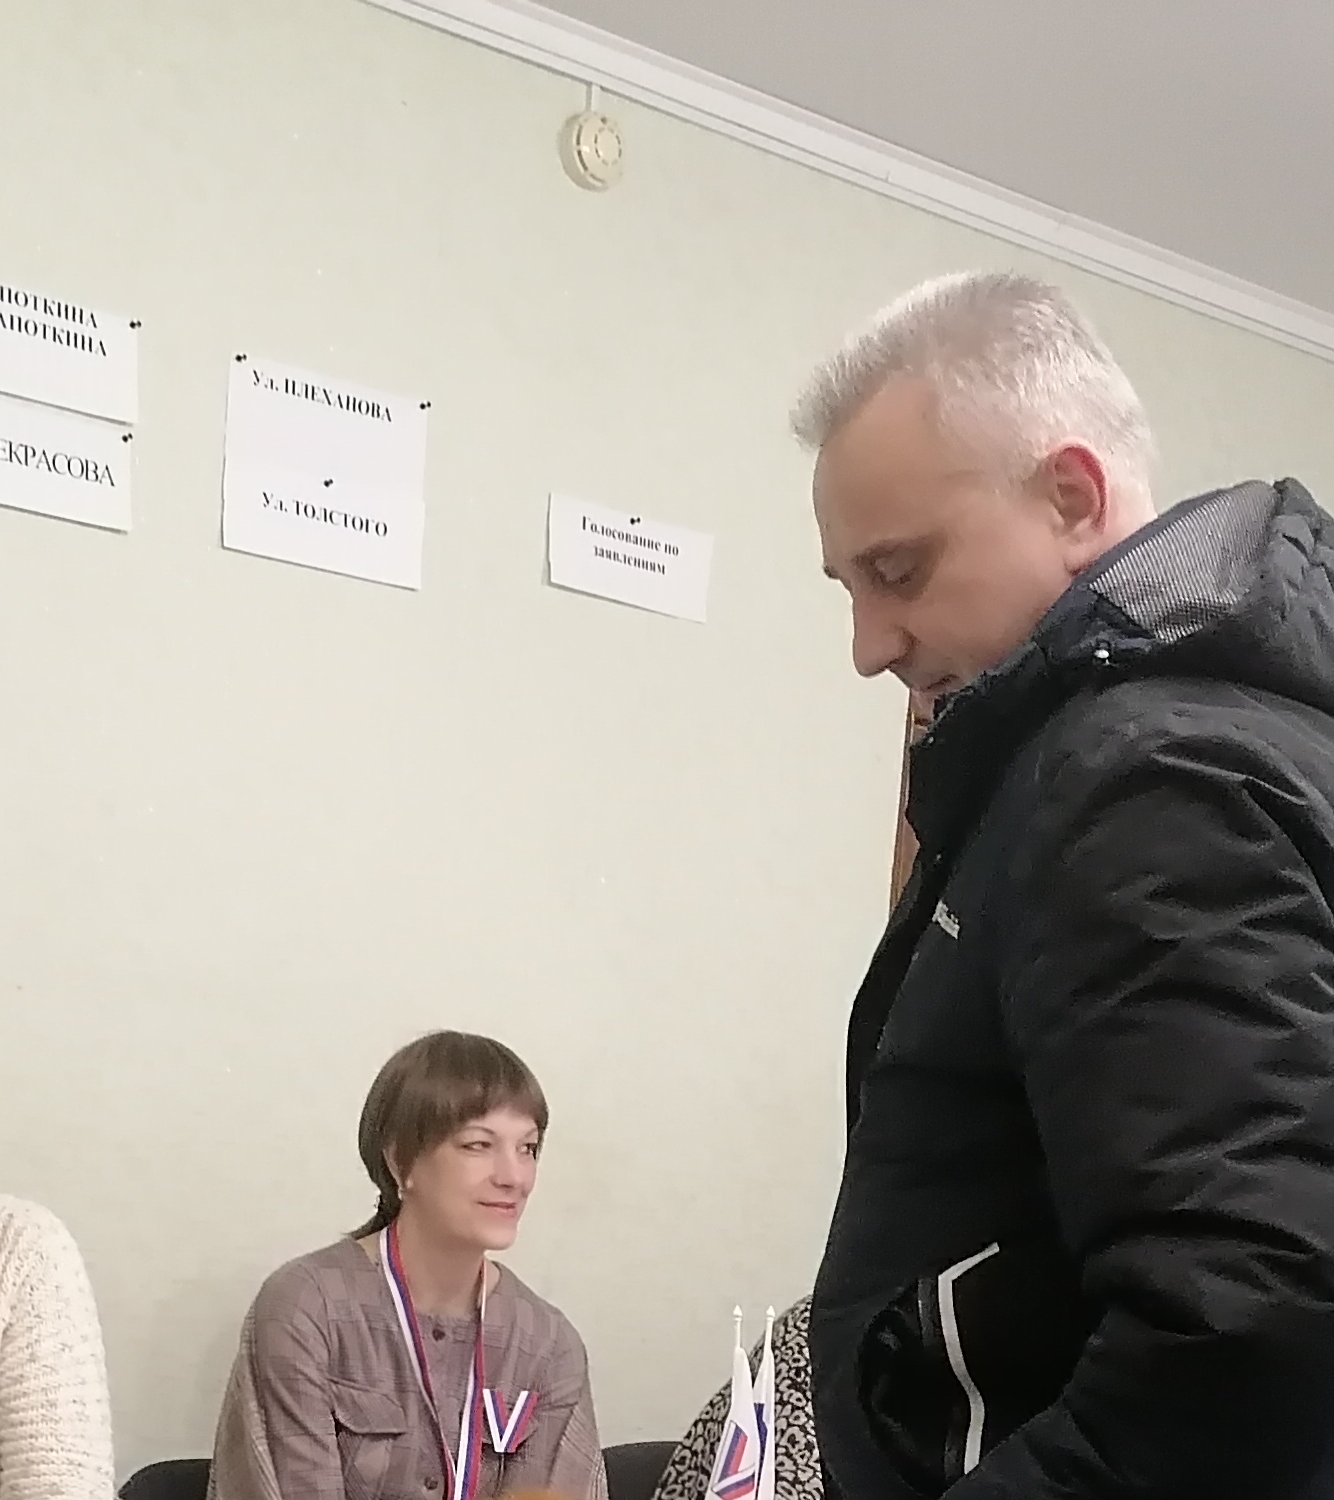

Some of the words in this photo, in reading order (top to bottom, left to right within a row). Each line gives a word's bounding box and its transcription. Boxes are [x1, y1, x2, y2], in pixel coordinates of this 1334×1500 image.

[252, 369, 279, 391] Ул.
[284, 378, 392, 422] ПЛЕХАНОВА
[262, 492, 288, 512] Ул.
[292, 499, 388, 538] ТОЛСТОГО
[581, 515, 661, 552] Голосование
[664, 543, 679, 557] по
[593, 545, 667, 575] заявлениям
